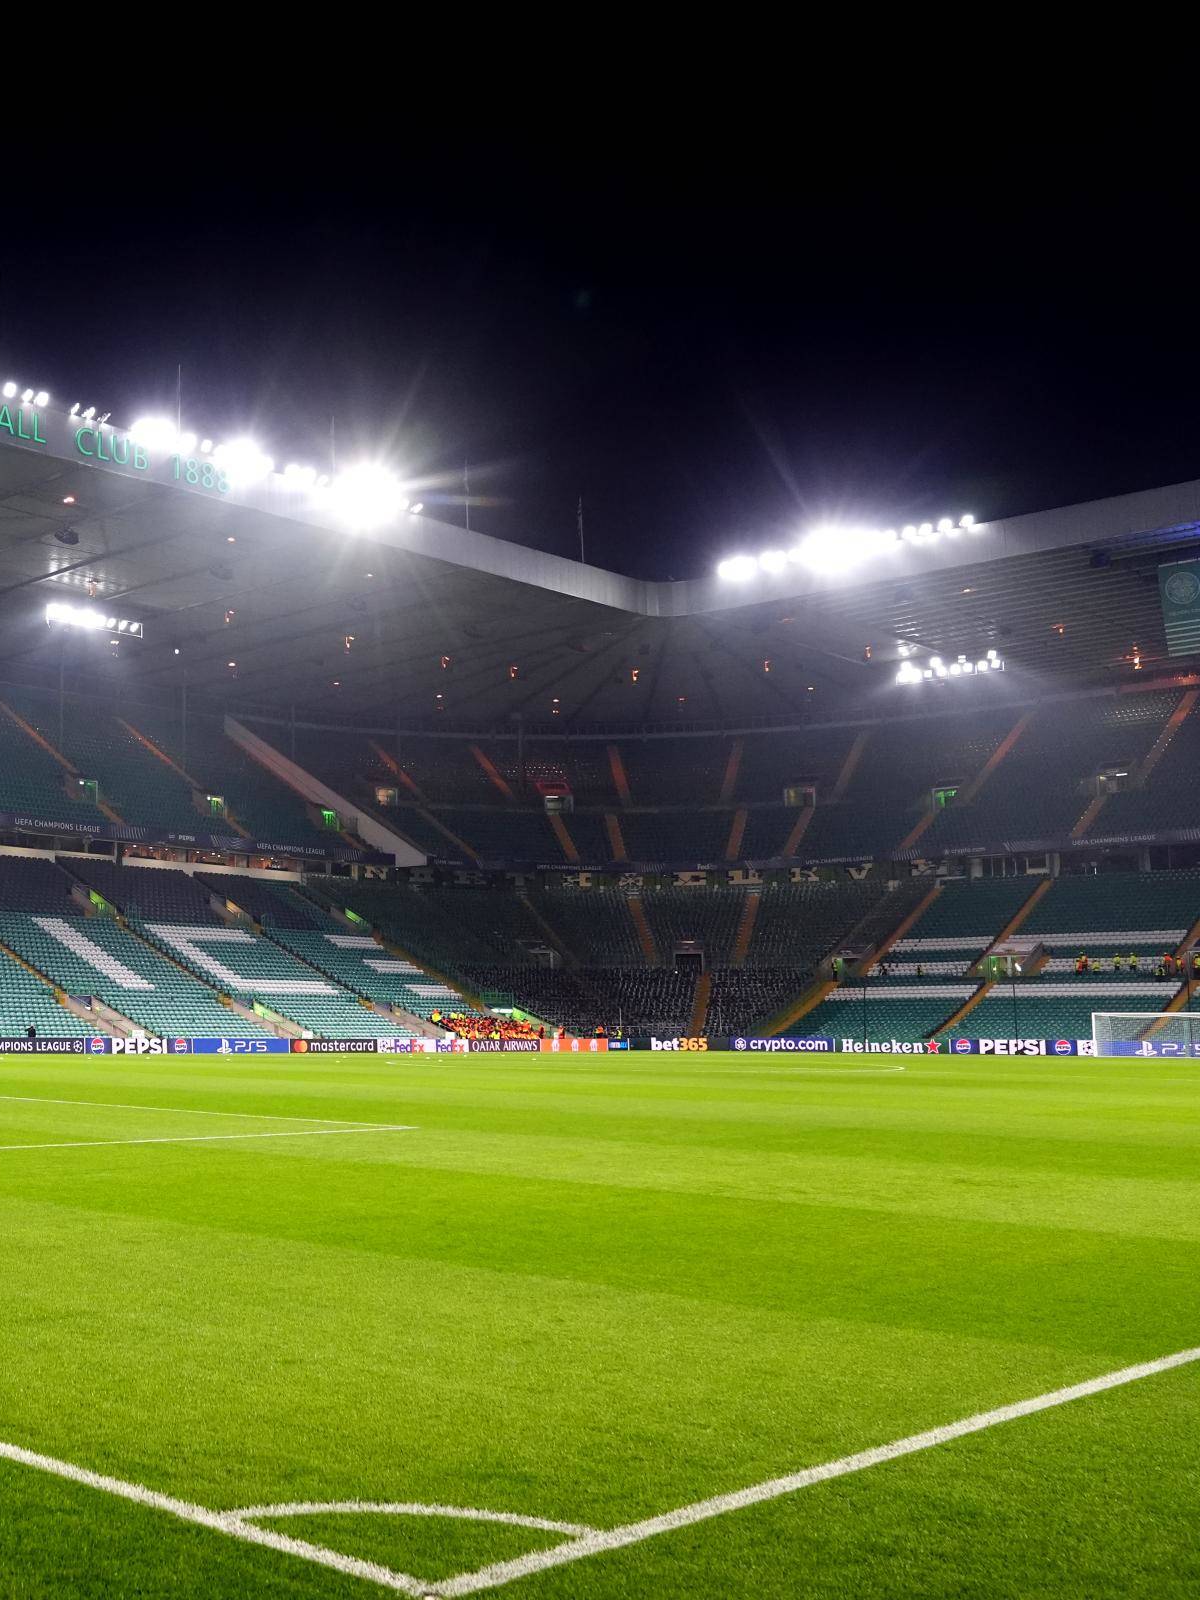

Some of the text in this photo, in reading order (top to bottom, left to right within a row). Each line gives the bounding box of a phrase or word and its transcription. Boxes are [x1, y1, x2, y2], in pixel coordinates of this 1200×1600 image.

[75, 428, 149, 470] CLUB
[172, 454, 230, 493] 1888
[14, 817, 101, 833] UEFA CHAMPIONS LEAGUE
[1130, 834, 1156, 842] LEAGUE
[273, 844, 304, 854] CHAMPIONS
[305, 847, 326, 856] LEAGUE
[36, 1041, 71, 1052] LEAGUE
[112, 1038, 167, 1054] PEPSI
[235, 1041, 267, 1052] PS5
[310, 1040, 374, 1051] mastercard
[394, 1039, 424, 1052] FedEx
[436, 1039, 464, 1052] FedEx
[472, 1041, 538, 1052] QATAR AIRWAYS
[650, 1037, 708, 1051] bet365
[750, 1038, 828, 1052] crypto.com
[841, 1039, 924, 1053] Heineken
[979, 1039, 1046, 1055] PEPSI
[1161, 1043, 1200, 1055] PS
